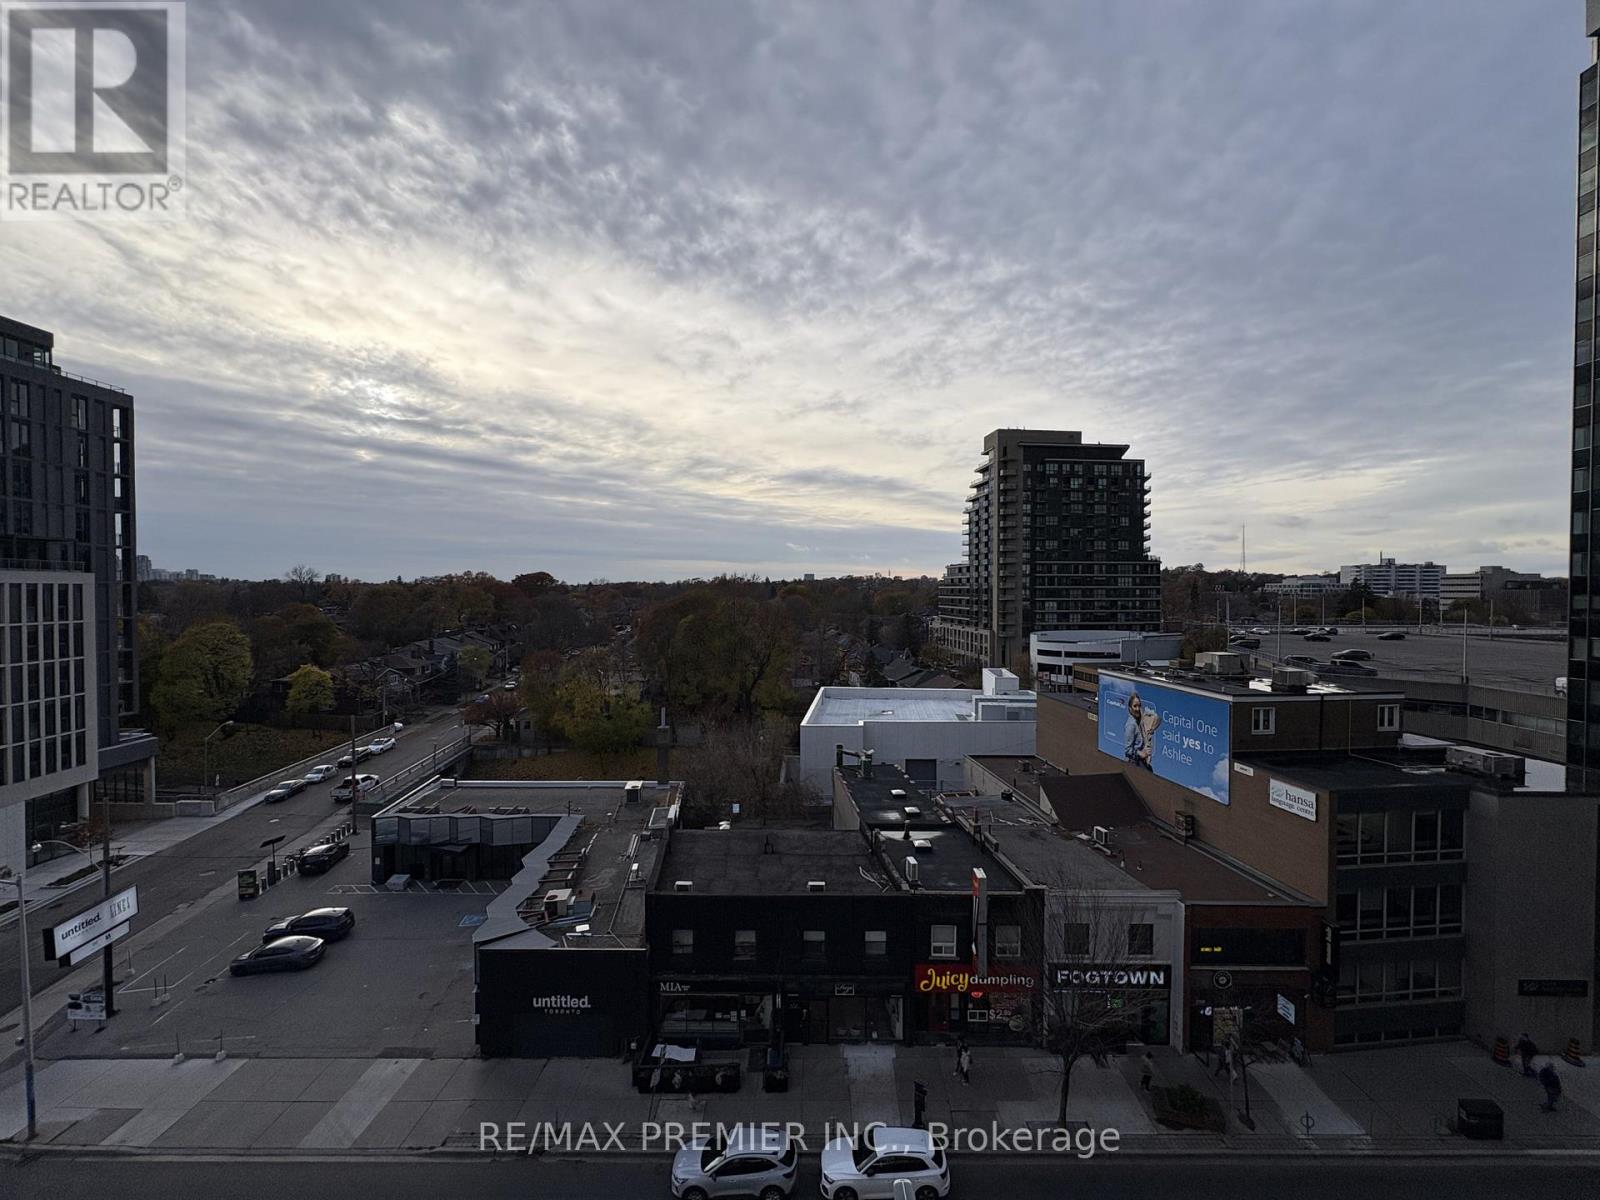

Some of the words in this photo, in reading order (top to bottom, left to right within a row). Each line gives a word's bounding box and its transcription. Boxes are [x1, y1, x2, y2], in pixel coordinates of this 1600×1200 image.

[1162, 710, 1194, 730] Capital
[1196, 719, 1218, 737] One
[1162, 729, 1180, 744] said
[1182, 736, 1201, 751] yes
[1203, 741, 1214, 755] to
[1162, 745, 1193, 766] Ashlee
[1285, 789, 1314, 809] hansa
[659, 981, 681, 991] MIA
[920, 968, 969, 992] Juicy
[969, 974, 1034, 988] dumpling
[1056, 969, 1165, 985] FOGTOWN
